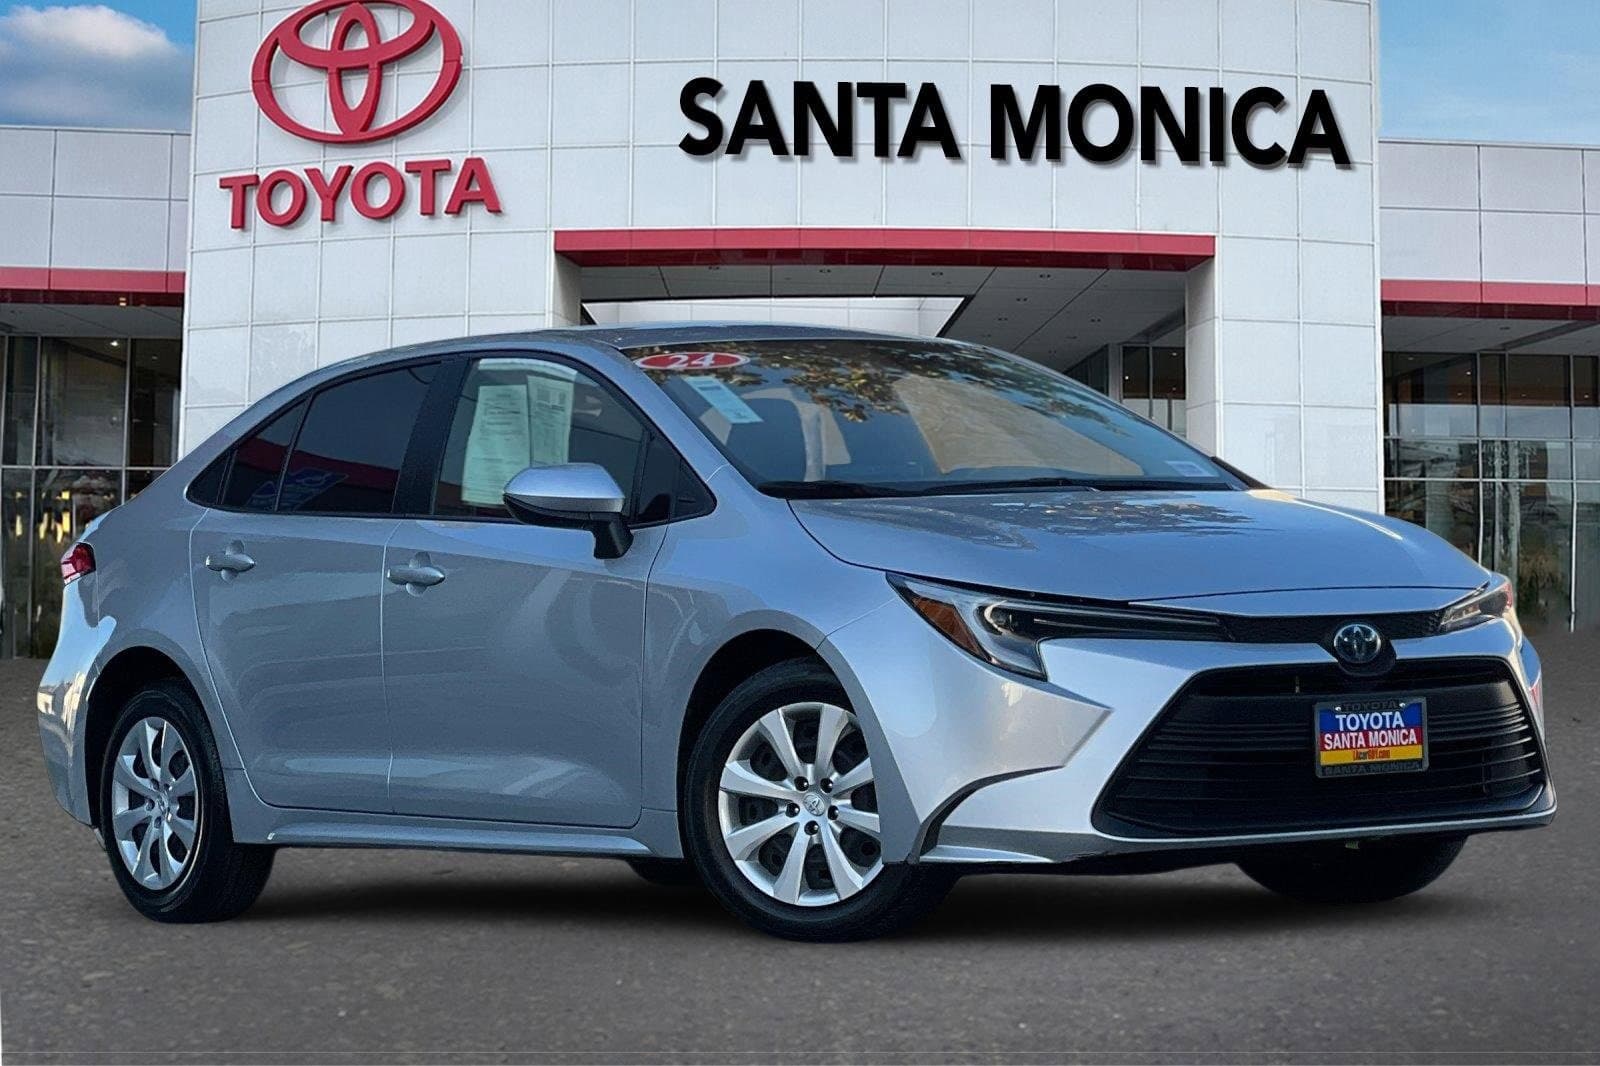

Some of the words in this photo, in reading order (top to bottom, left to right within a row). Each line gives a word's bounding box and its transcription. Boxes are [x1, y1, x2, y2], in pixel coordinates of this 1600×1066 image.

[679, 77, 962, 161] SANTA
[990, 83, 1353, 169] MONICA
[219, 157, 503, 230] TOYOTA
[667, 352, 715, 369] 24
[1335, 711, 1405, 732] TOYOTA
[1324, 732, 1366, 750] SANTA
[1369, 729, 1417, 747] MONICA
